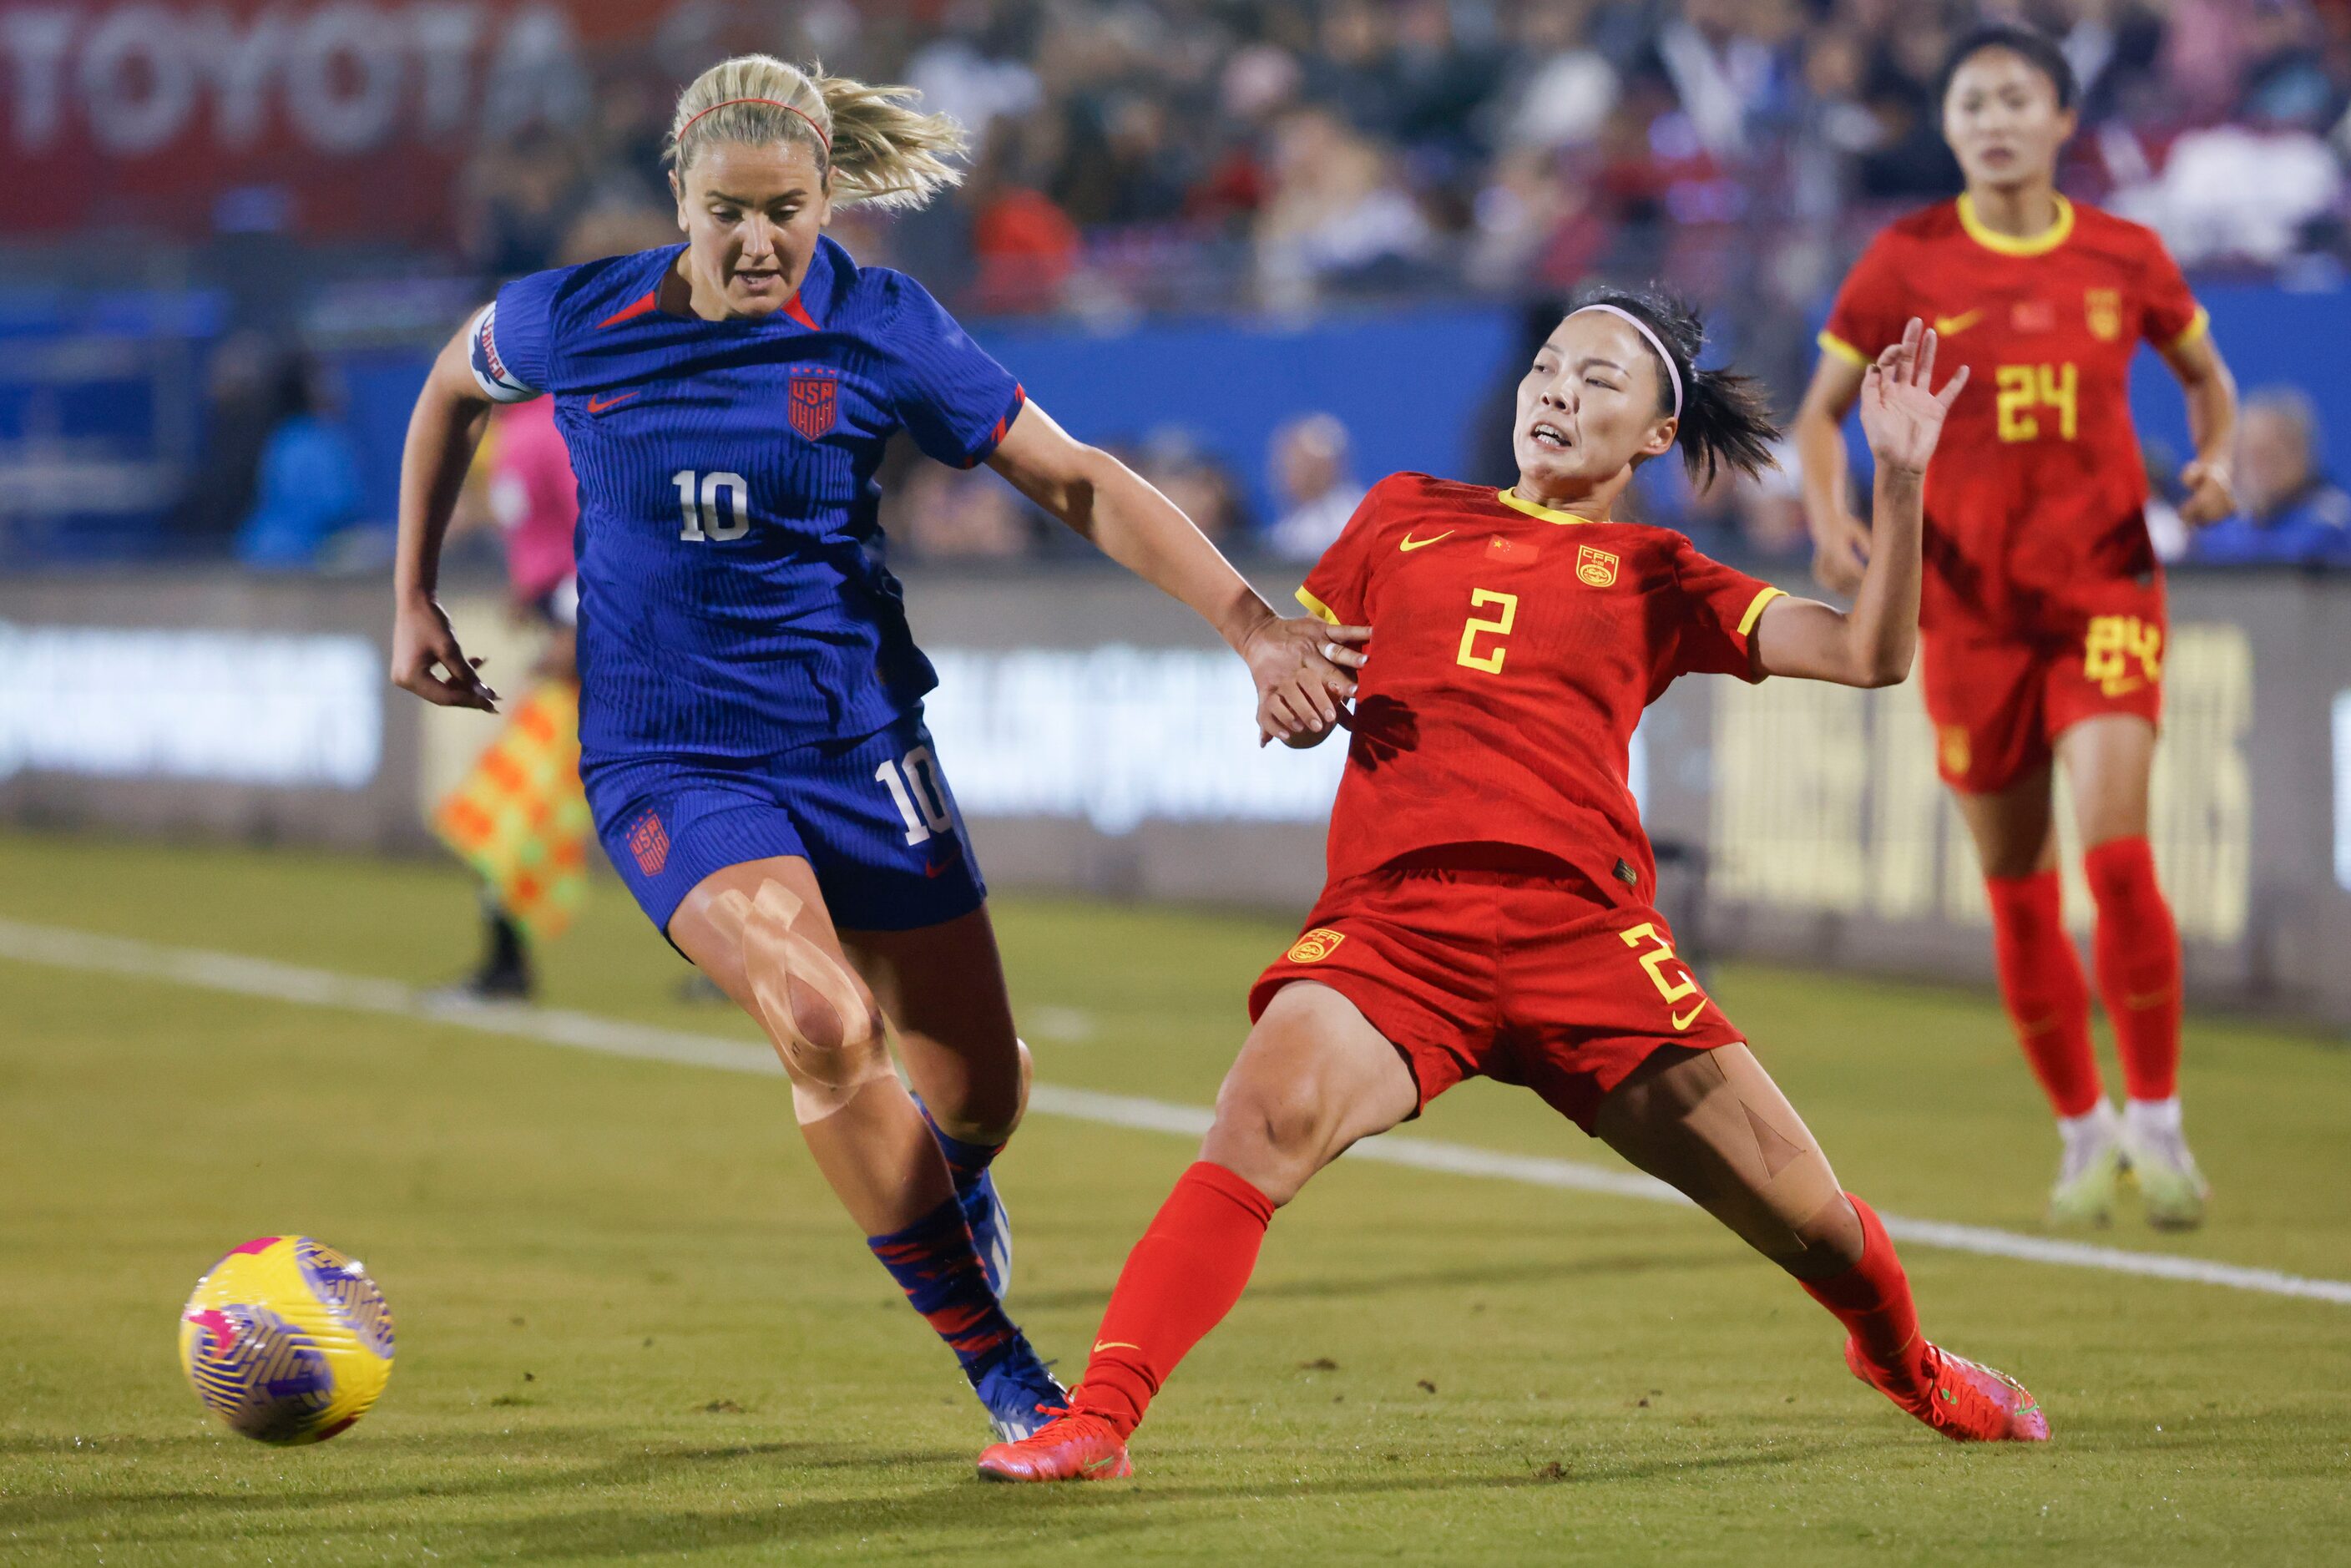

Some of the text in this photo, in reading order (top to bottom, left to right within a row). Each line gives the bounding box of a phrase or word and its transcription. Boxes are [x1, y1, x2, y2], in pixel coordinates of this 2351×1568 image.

[3, 5, 591, 154] TOYOTA
[792, 382, 832, 406] USA
[1996, 362, 2078, 443] 24
[672, 469, 750, 542] 10
[1583, 549, 1615, 564] CFA
[1456, 587, 1518, 675] 2
[2085, 615, 2161, 683] 24
[875, 746, 951, 847] 10
[632, 819, 659, 856] USA
[1619, 922, 1697, 1004] 2
